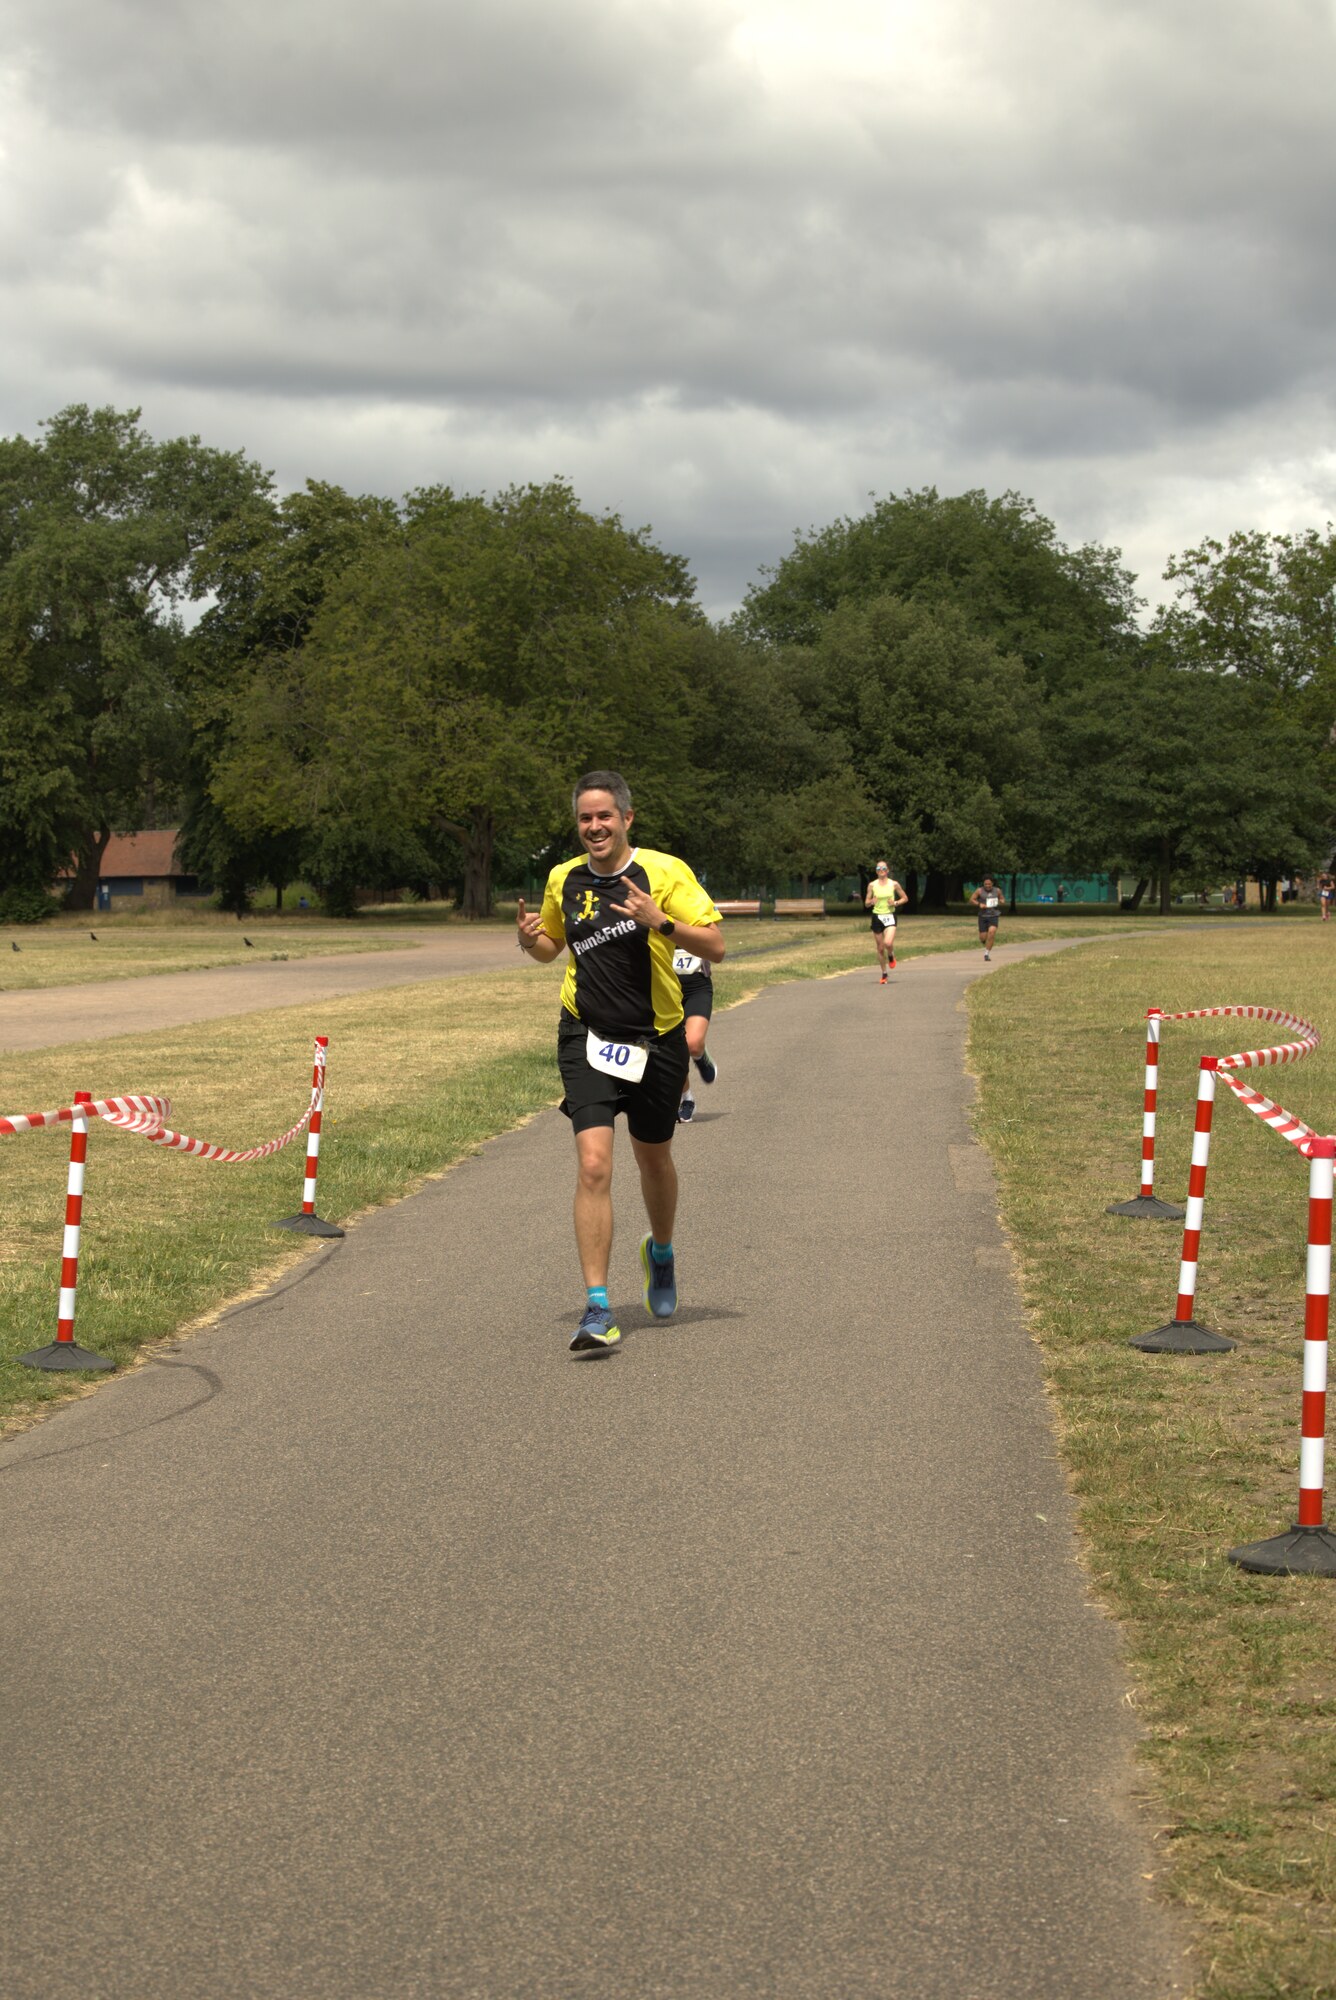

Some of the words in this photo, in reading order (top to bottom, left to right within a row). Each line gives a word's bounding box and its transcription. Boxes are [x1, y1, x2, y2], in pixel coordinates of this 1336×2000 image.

[572, 919, 637, 956] Run&Frite
[676, 957, 693, 969] 47
[599, 1043, 631, 1066] 40
